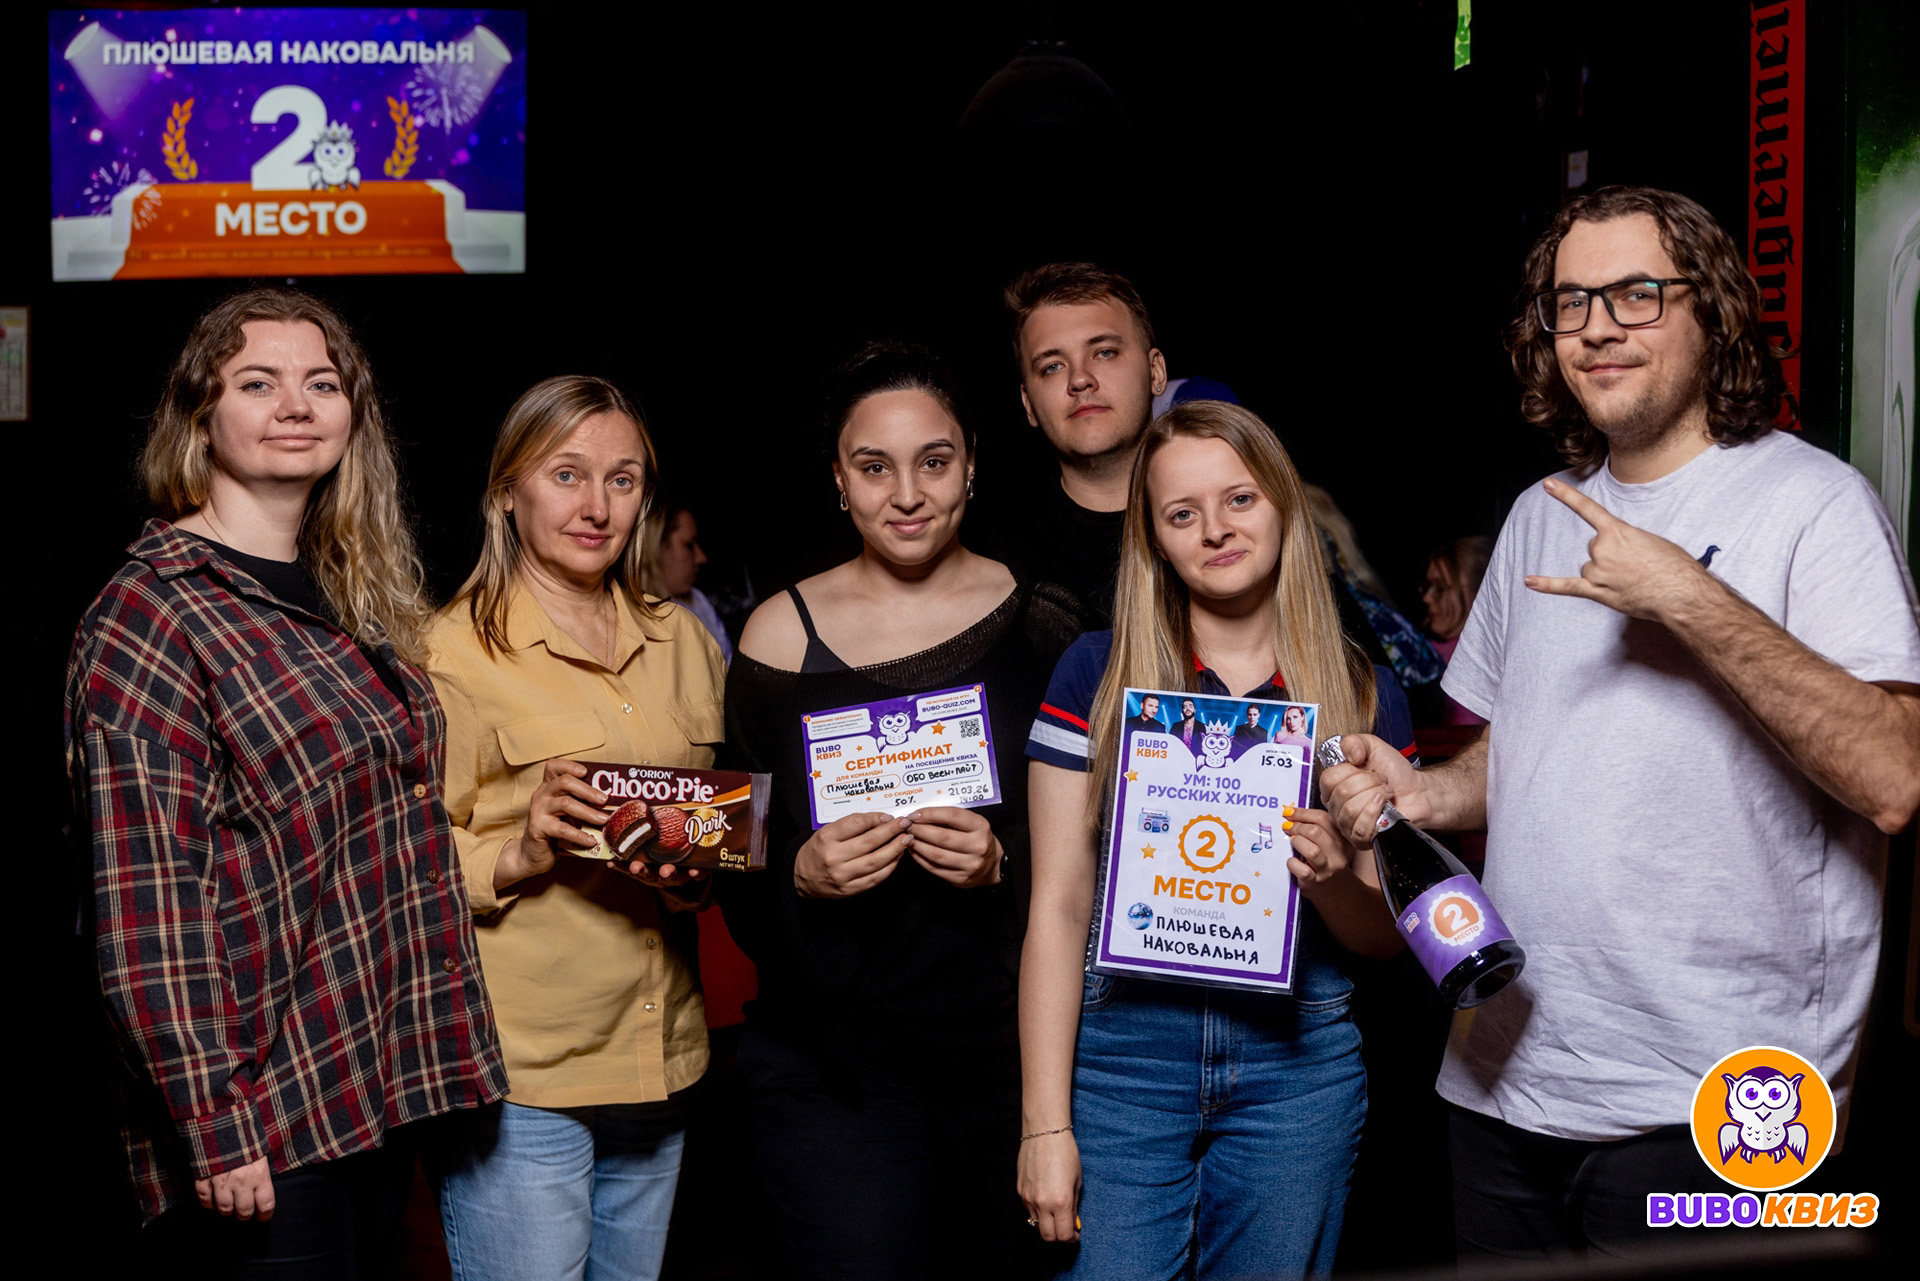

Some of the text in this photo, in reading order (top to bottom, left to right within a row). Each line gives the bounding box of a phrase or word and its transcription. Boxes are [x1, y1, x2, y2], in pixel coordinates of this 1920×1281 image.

[103, 40, 475, 65] ПЛЮШЕВАЯ НАКОВАЛЬНЯ
[250, 84, 329, 191] 2
[215, 201, 368, 237] МЕСТО
[921, 698, 976, 713] BUBO-QUIZ.COM
[815, 743, 842, 754] BUBO
[1137, 738, 1169, 750] BUBO
[816, 750, 843, 761] КВИЗ
[845, 743, 953, 771] СЕРТИФИКАТ
[915, 757, 955, 768] ПОСЕЩЕНИЕ
[956, 753, 978, 761] КВИЗА
[1136, 748, 1168, 759] КВИЗ
[1261, 755, 1293, 768] 15.03
[638, 769, 673, 779] ORION
[850, 769, 884, 779] КОМАНДЫ
[1183, 773, 1241, 790] УМ: 100
[893, 787, 924, 798] СКИДКОЙ
[1146, 784, 1279, 809] РУССКИХ ХИТОВ
[684, 810, 733, 844] Dark
[1195, 830, 1217, 859] 2
[720, 847, 729, 861] 6
[1153, 875, 1252, 905] МЕСТО
[1172, 906, 1226, 921] КОМАНДА
[1442, 903, 1471, 933] 2
[1156, 916, 1255, 942] ПЛЮШЕВАЯ
[1453, 925, 1480, 943] МЕСТО
[1143, 933, 1259, 965] НАКОВАЛЬНЯ
